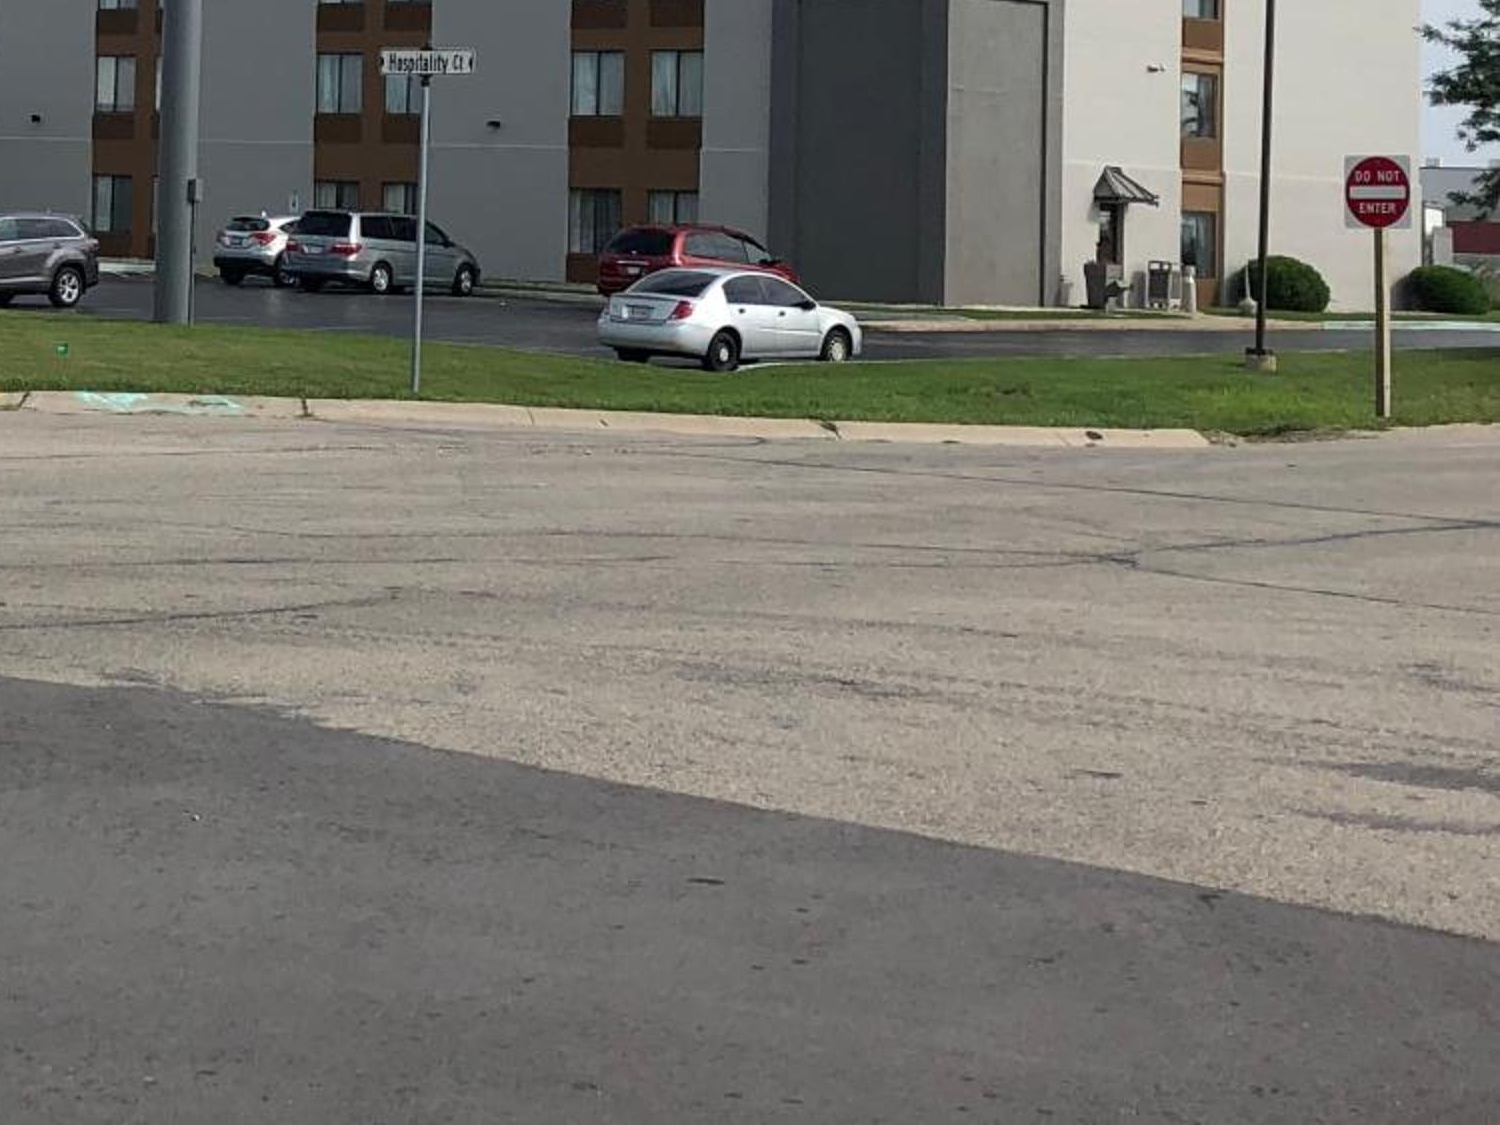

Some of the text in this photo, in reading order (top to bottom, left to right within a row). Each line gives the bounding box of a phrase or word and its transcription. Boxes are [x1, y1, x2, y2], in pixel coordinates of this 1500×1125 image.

[389, 54, 463, 74] Hospitality Ct
[1355, 171, 1400, 182] DO NOT
[1359, 203, 1396, 214] ENTER
